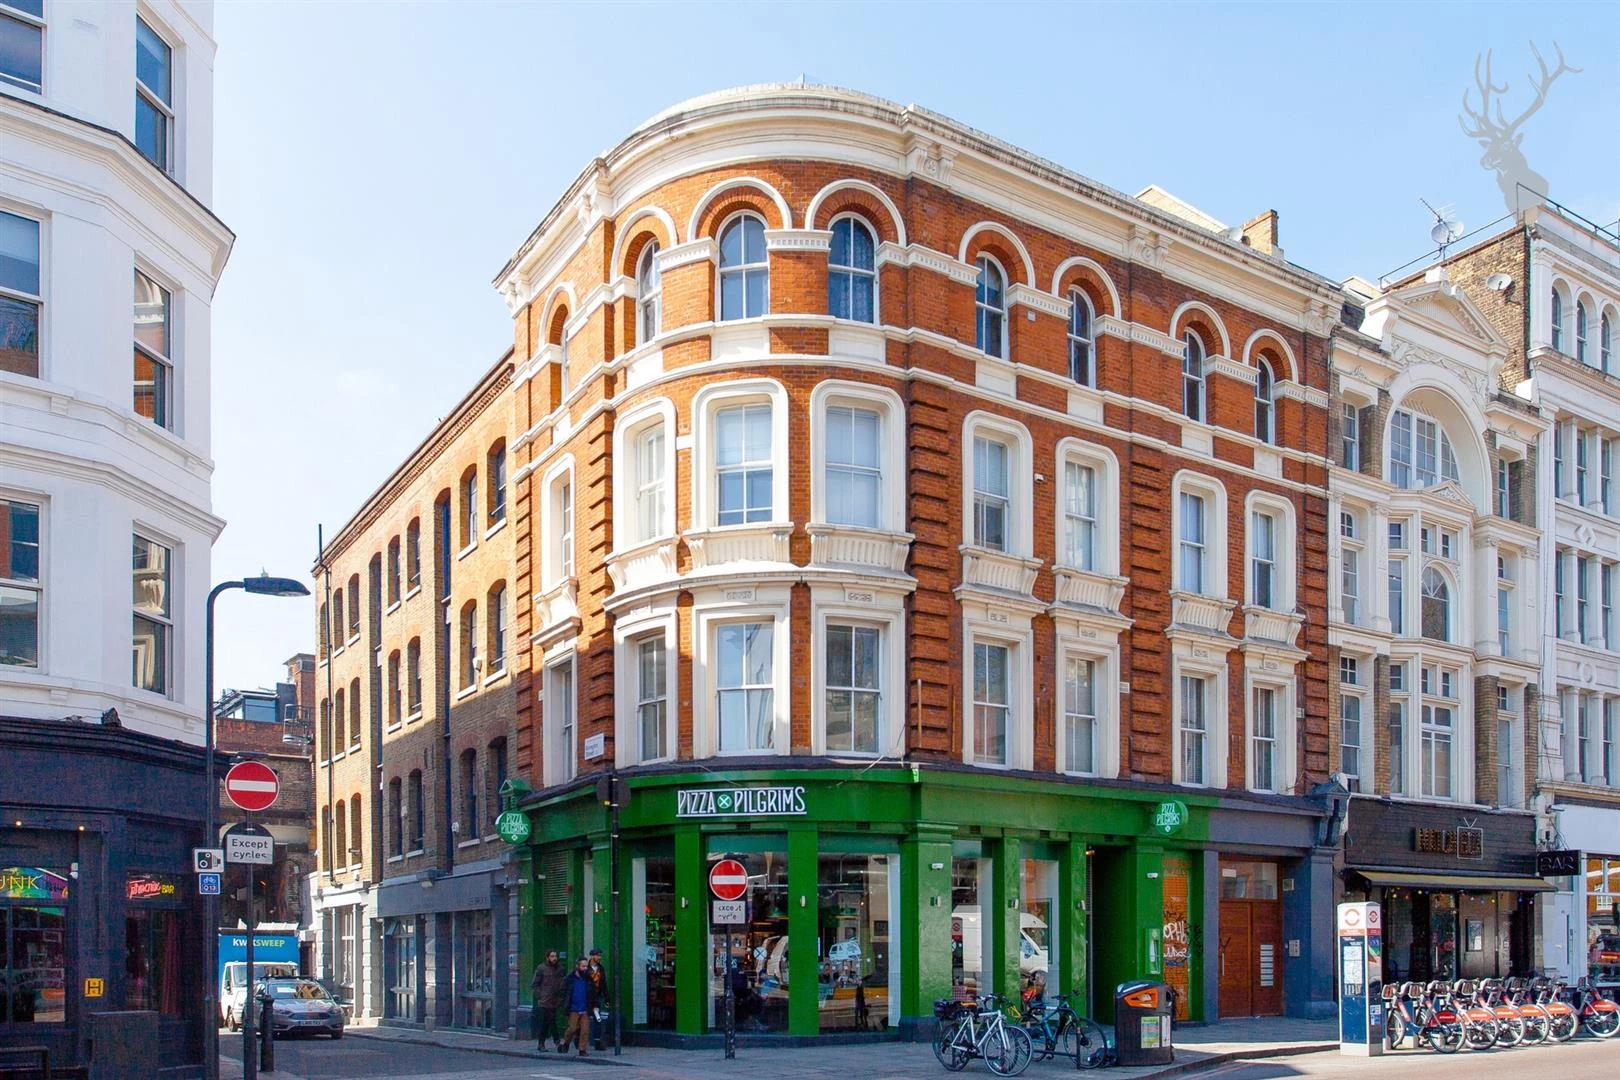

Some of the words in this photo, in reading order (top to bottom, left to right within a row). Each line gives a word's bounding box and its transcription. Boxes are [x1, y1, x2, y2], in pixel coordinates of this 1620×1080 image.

[677, 790, 717, 815] PIZZA
[734, 786, 806, 813] PILGRIMS
[506, 813, 523, 824] PIZZA
[231, 838, 269, 849] Except
[233, 938, 285, 947] KWSWEEP
[87, 980, 101, 995] H
